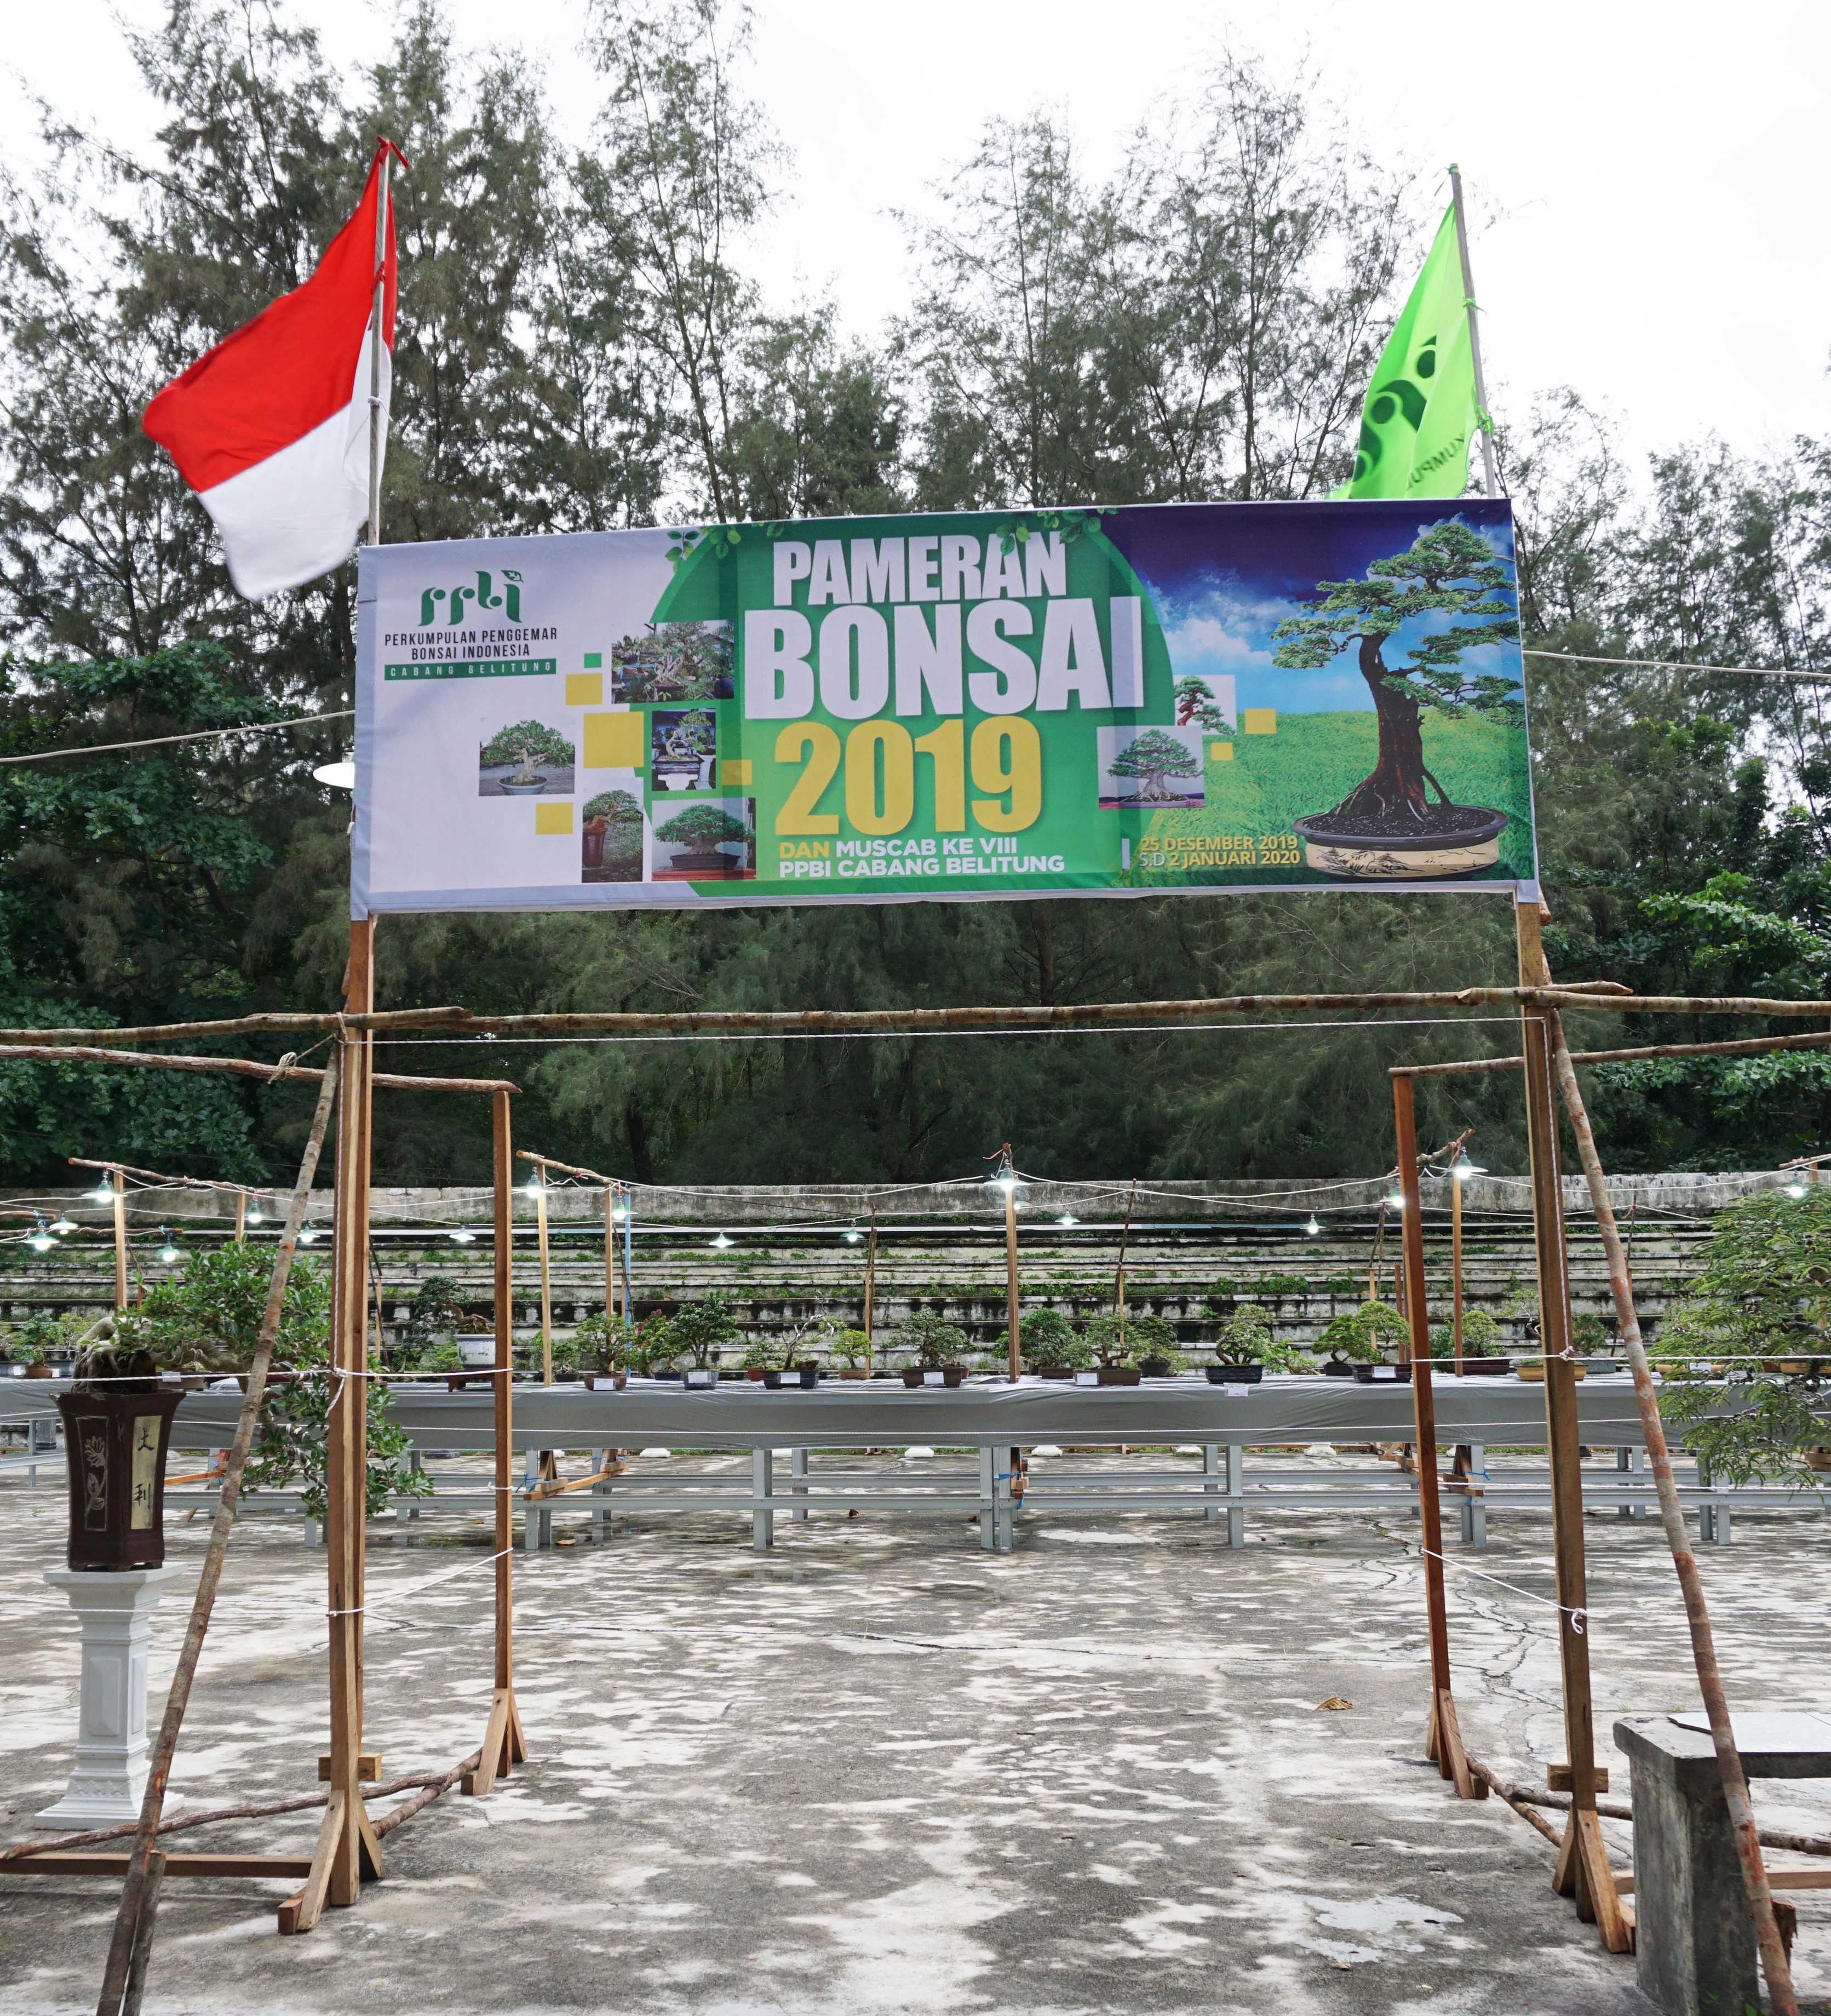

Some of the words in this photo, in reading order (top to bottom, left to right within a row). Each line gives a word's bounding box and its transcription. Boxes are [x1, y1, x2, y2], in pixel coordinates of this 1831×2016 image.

[773, 531, 1066, 606] PAMERAN
[385, 631, 475, 646] PERKUMPULAN
[482, 628, 557, 642] PENGGEMAR
[412, 646, 457, 660] BONSAI
[463, 644, 530, 658] INDONESIA
[744, 595, 1144, 719] BONSAI
[391, 666, 454, 677] CABANG
[468, 662, 550, 674] BELITUNG
[774, 715, 1042, 836] 2019
[779, 841, 829, 858] DAN
[836, 839, 937, 857] MUSCAB
[943, 838, 973, 855] KE
[979, 837, 1017, 854] VIII
[1141, 837, 1160, 851] 25
[1164, 836, 1254, 851] DESEMBER
[1259, 835, 1298, 850] 2019
[779, 861, 830, 878] PPBI
[838, 858, 939, 876] CABANG
[946, 855, 1065, 874] BELITUNG
[1139, 852, 1165, 866] S.D
[1169, 852, 1180, 866] 2
[1181, 851, 1256, 869] JANUARI
[1261, 850, 1300, 864] 2020
